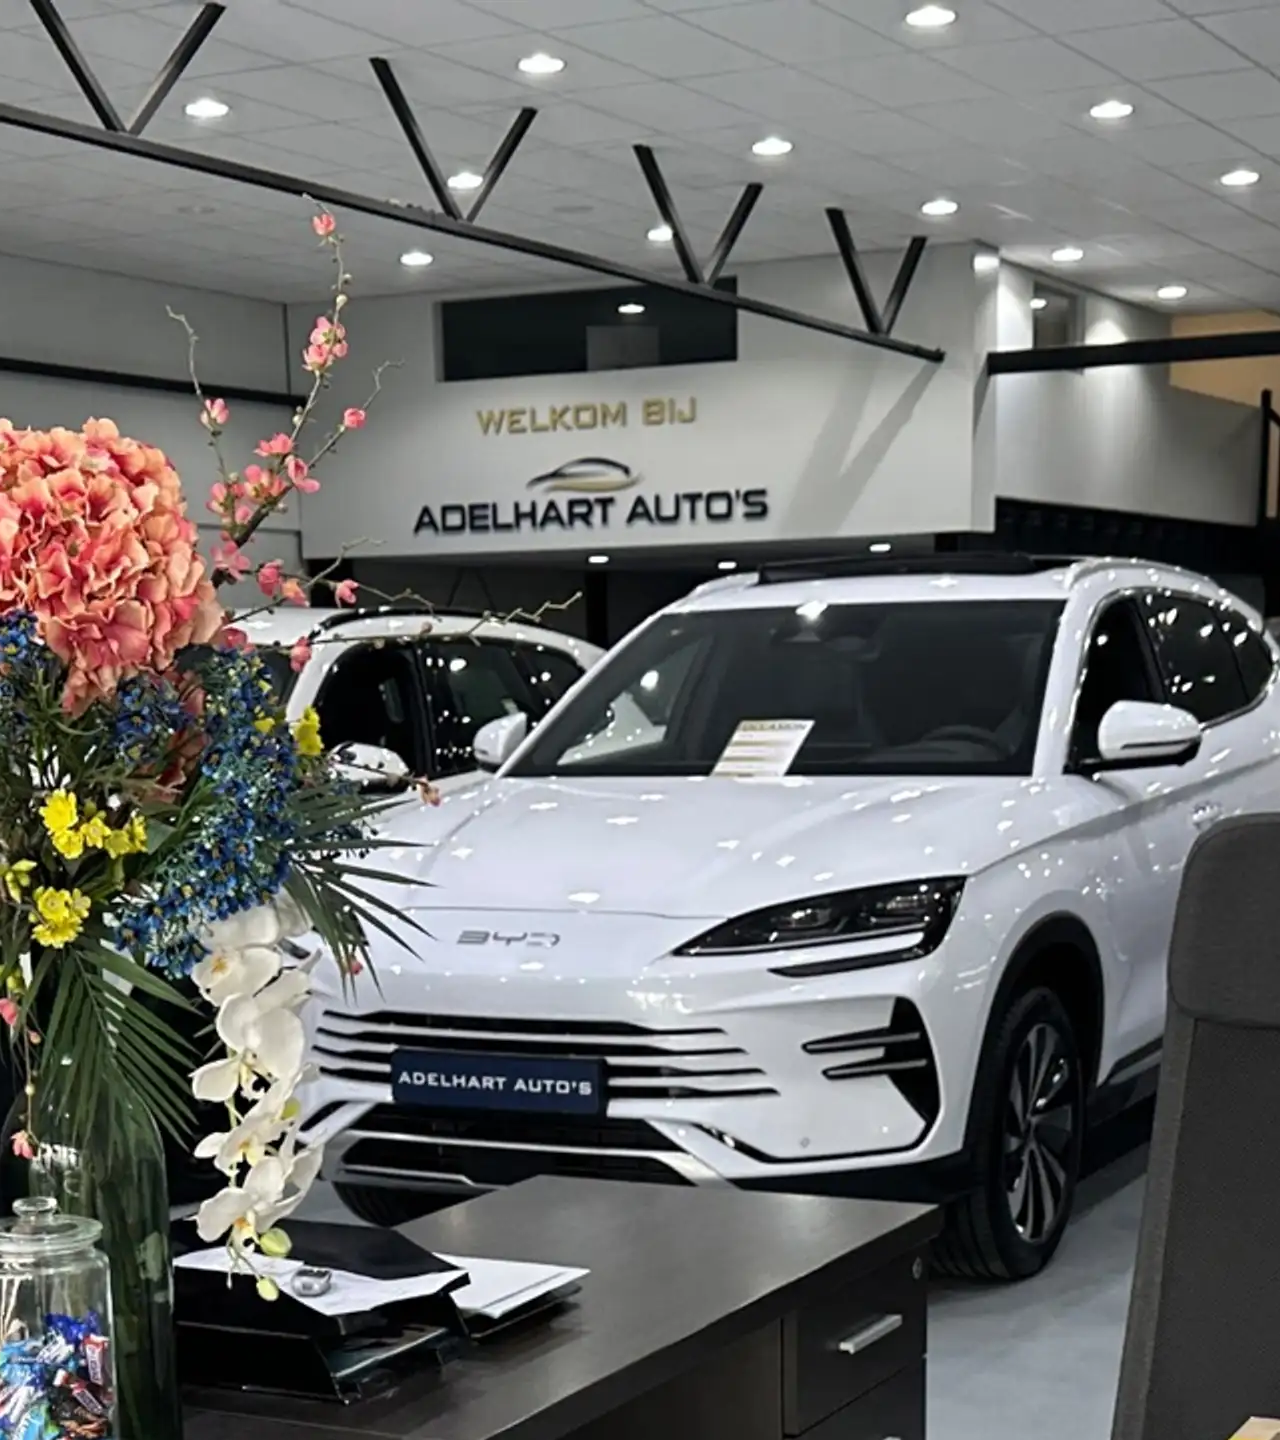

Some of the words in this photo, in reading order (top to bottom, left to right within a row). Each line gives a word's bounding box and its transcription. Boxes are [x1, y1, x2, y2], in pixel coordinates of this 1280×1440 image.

[476, 403, 628, 436] WELKOM
[642, 397, 697, 427] BIJ
[414, 497, 615, 536] ADELHART
[626, 489, 769, 525] AUTO'S
[398, 1070, 507, 1092] ADELHART
[514, 1078, 592, 1095] AUTO'S
